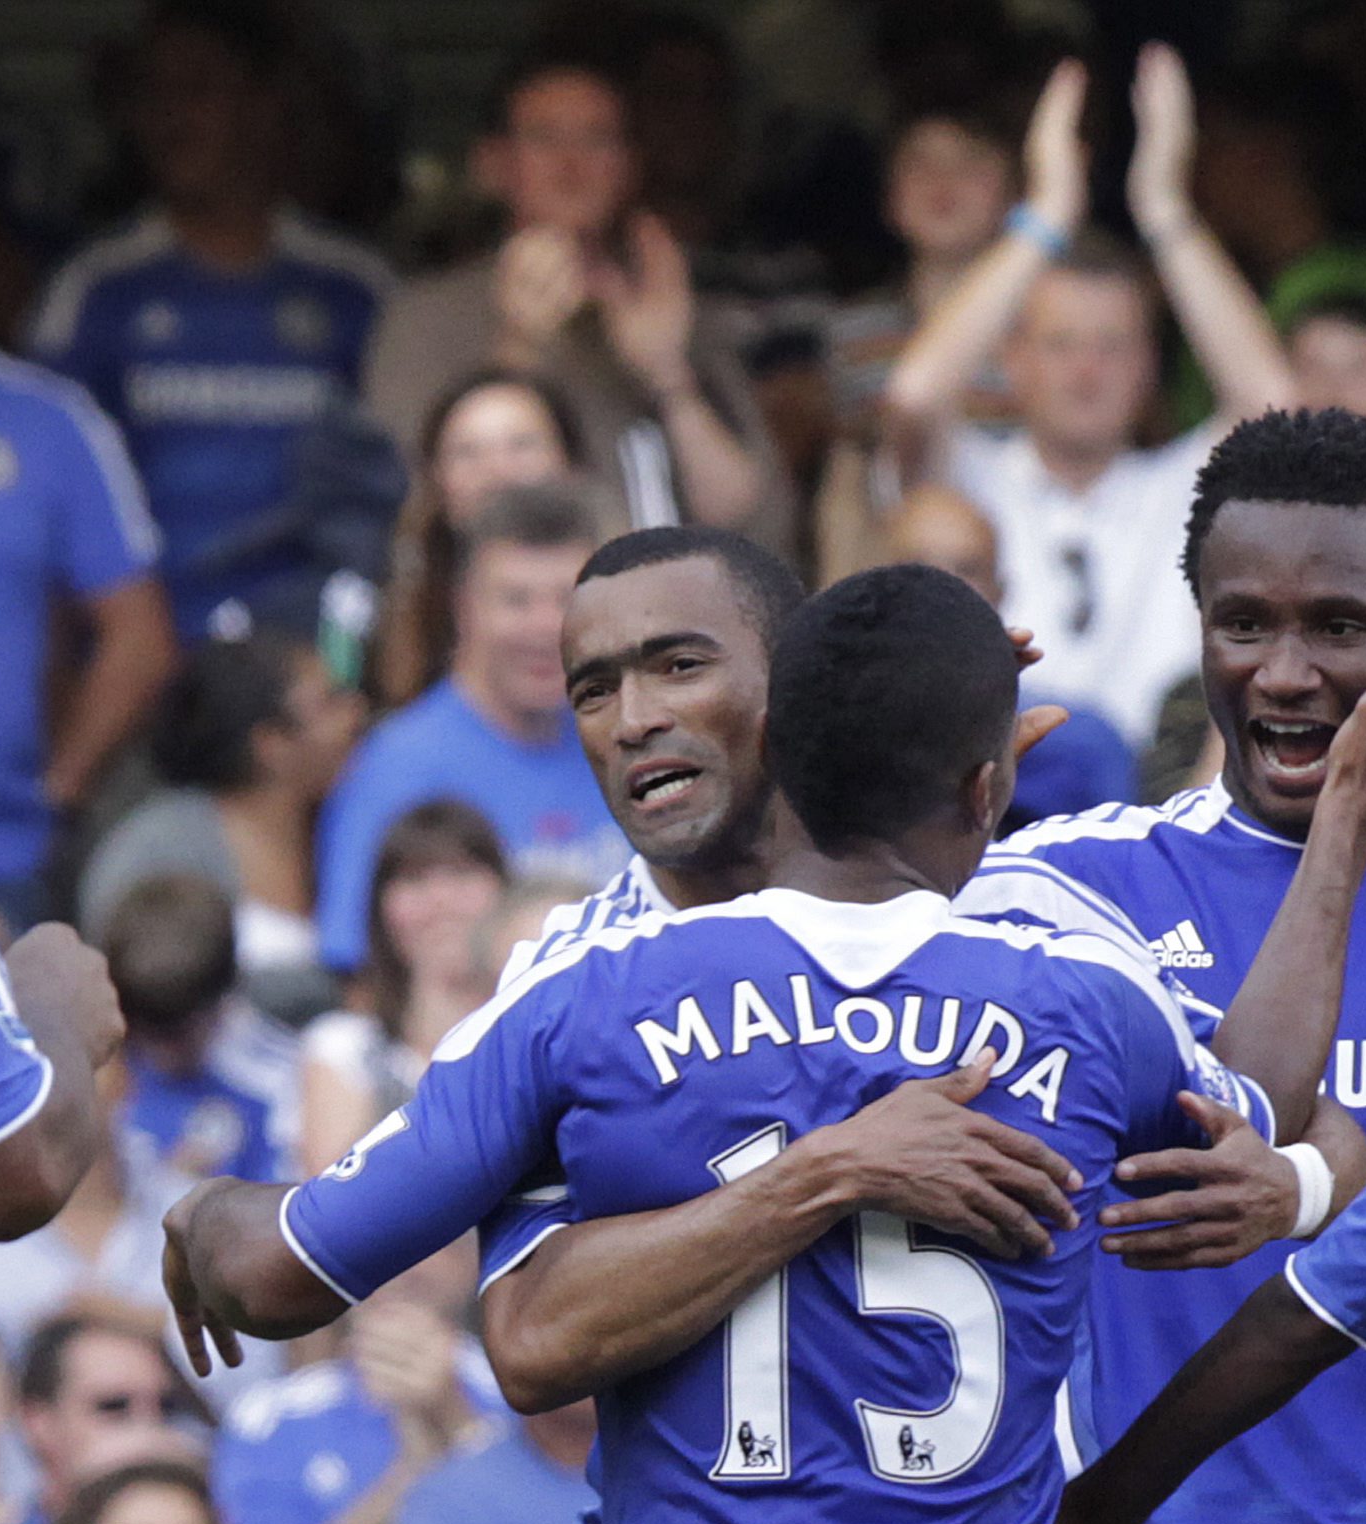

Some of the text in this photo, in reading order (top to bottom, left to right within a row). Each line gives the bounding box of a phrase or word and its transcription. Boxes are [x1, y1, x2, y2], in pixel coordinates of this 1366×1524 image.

[1153, 949, 1215, 969] didas
[634, 974, 1071, 1124] MALOUDA
[706, 1120, 1006, 1484] 15
